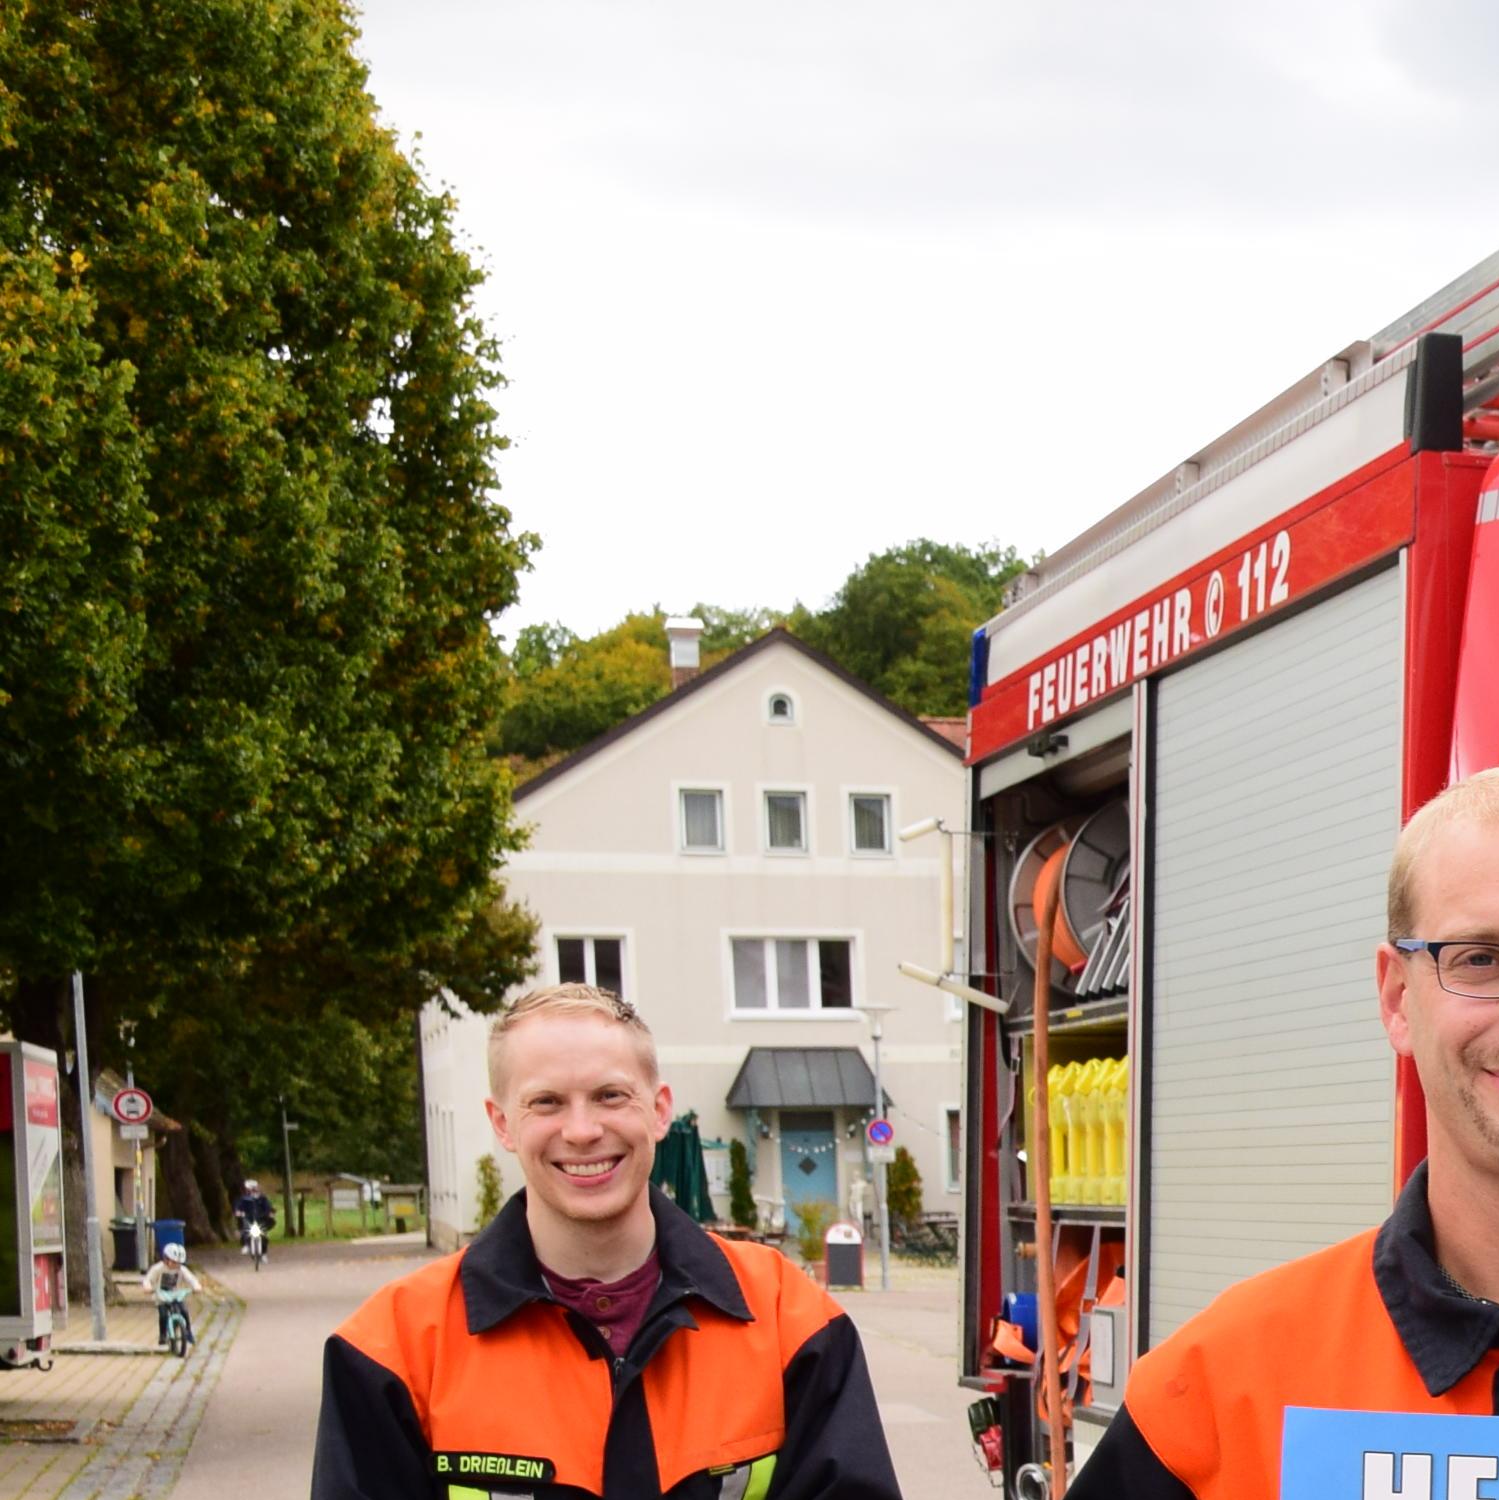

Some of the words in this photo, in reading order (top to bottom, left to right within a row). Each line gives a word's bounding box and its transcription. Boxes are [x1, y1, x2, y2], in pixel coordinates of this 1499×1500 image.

[1026, 586, 1192, 731] FEUERWEHR
[1237, 529, 1291, 621] 112
[437, 1455, 453, 1472] B.
